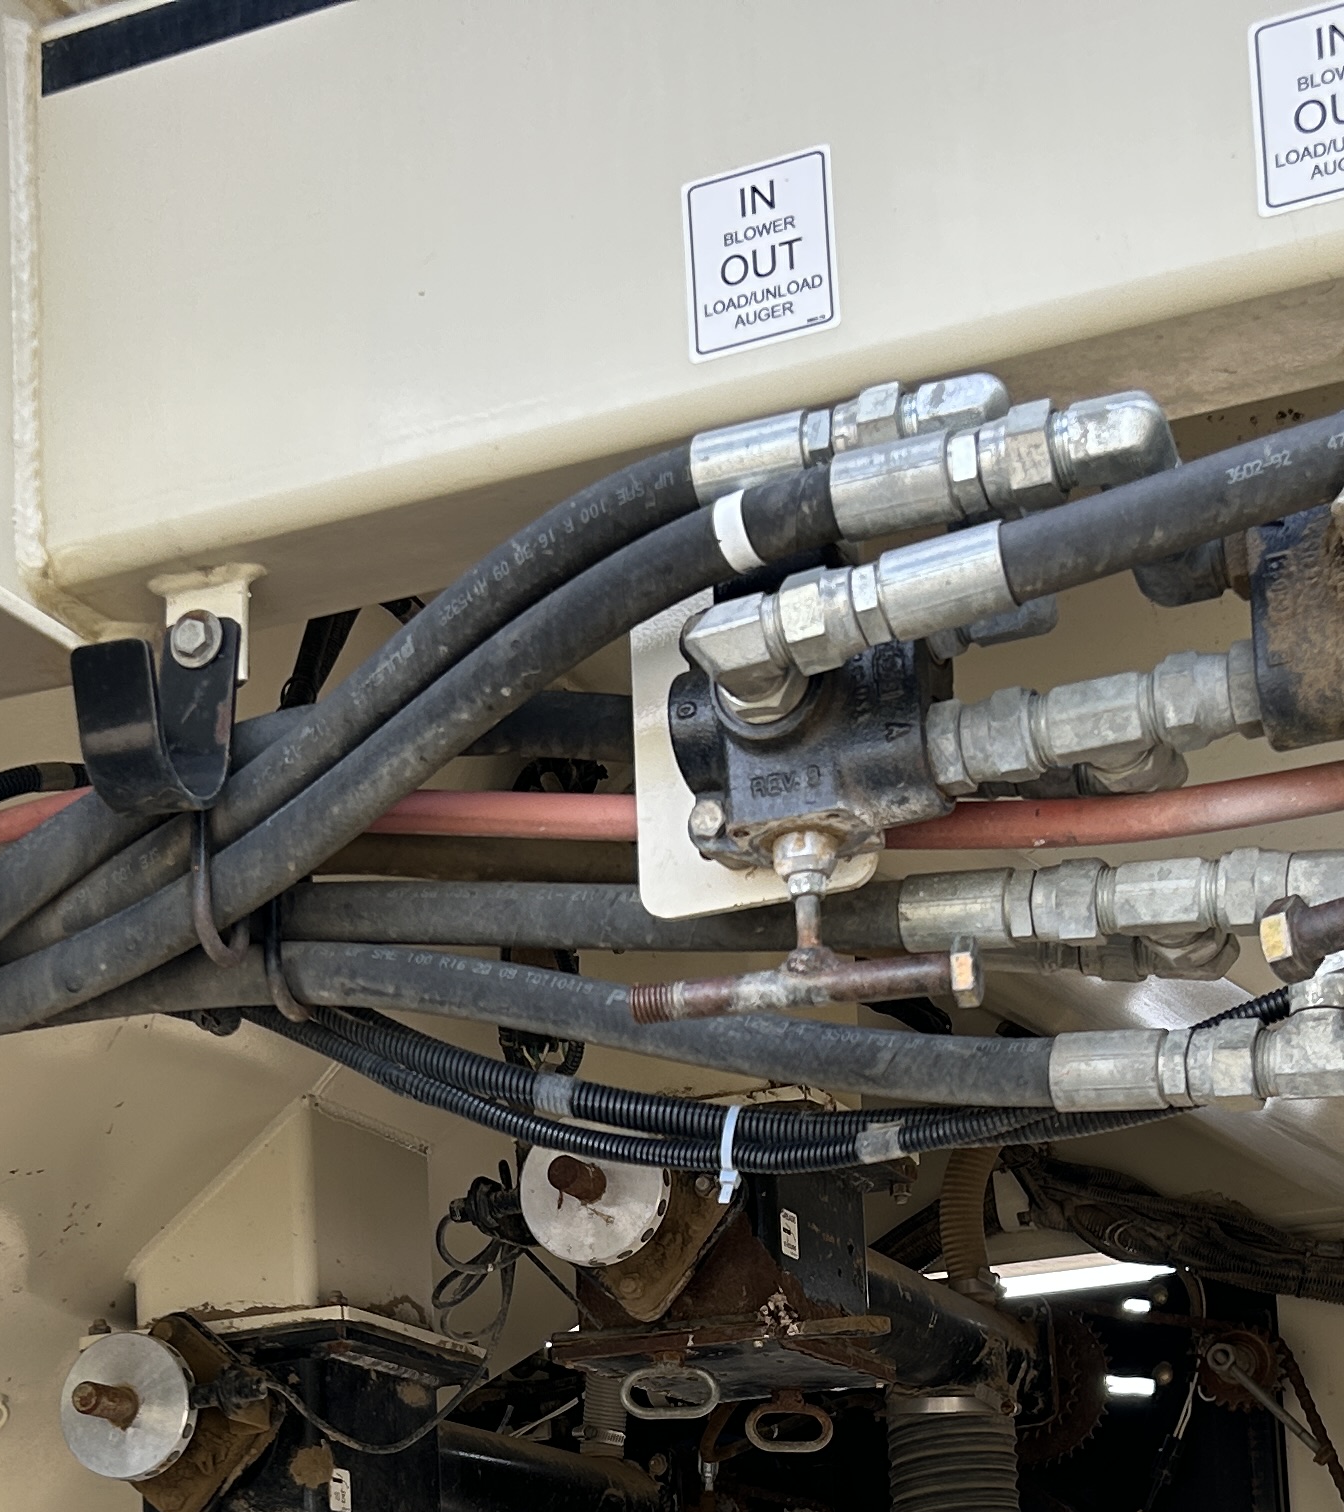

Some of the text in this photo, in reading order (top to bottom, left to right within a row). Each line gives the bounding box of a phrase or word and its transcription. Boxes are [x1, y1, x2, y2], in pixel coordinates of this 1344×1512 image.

[739, 179, 776, 218] IN
[723, 215, 796, 247] BLOWER
[720, 236, 803, 286] OUT
[704, 274, 823, 318] LOAD/UNLOAD
[734, 300, 795, 329] AUGER
[579, 498, 607, 524] 100
